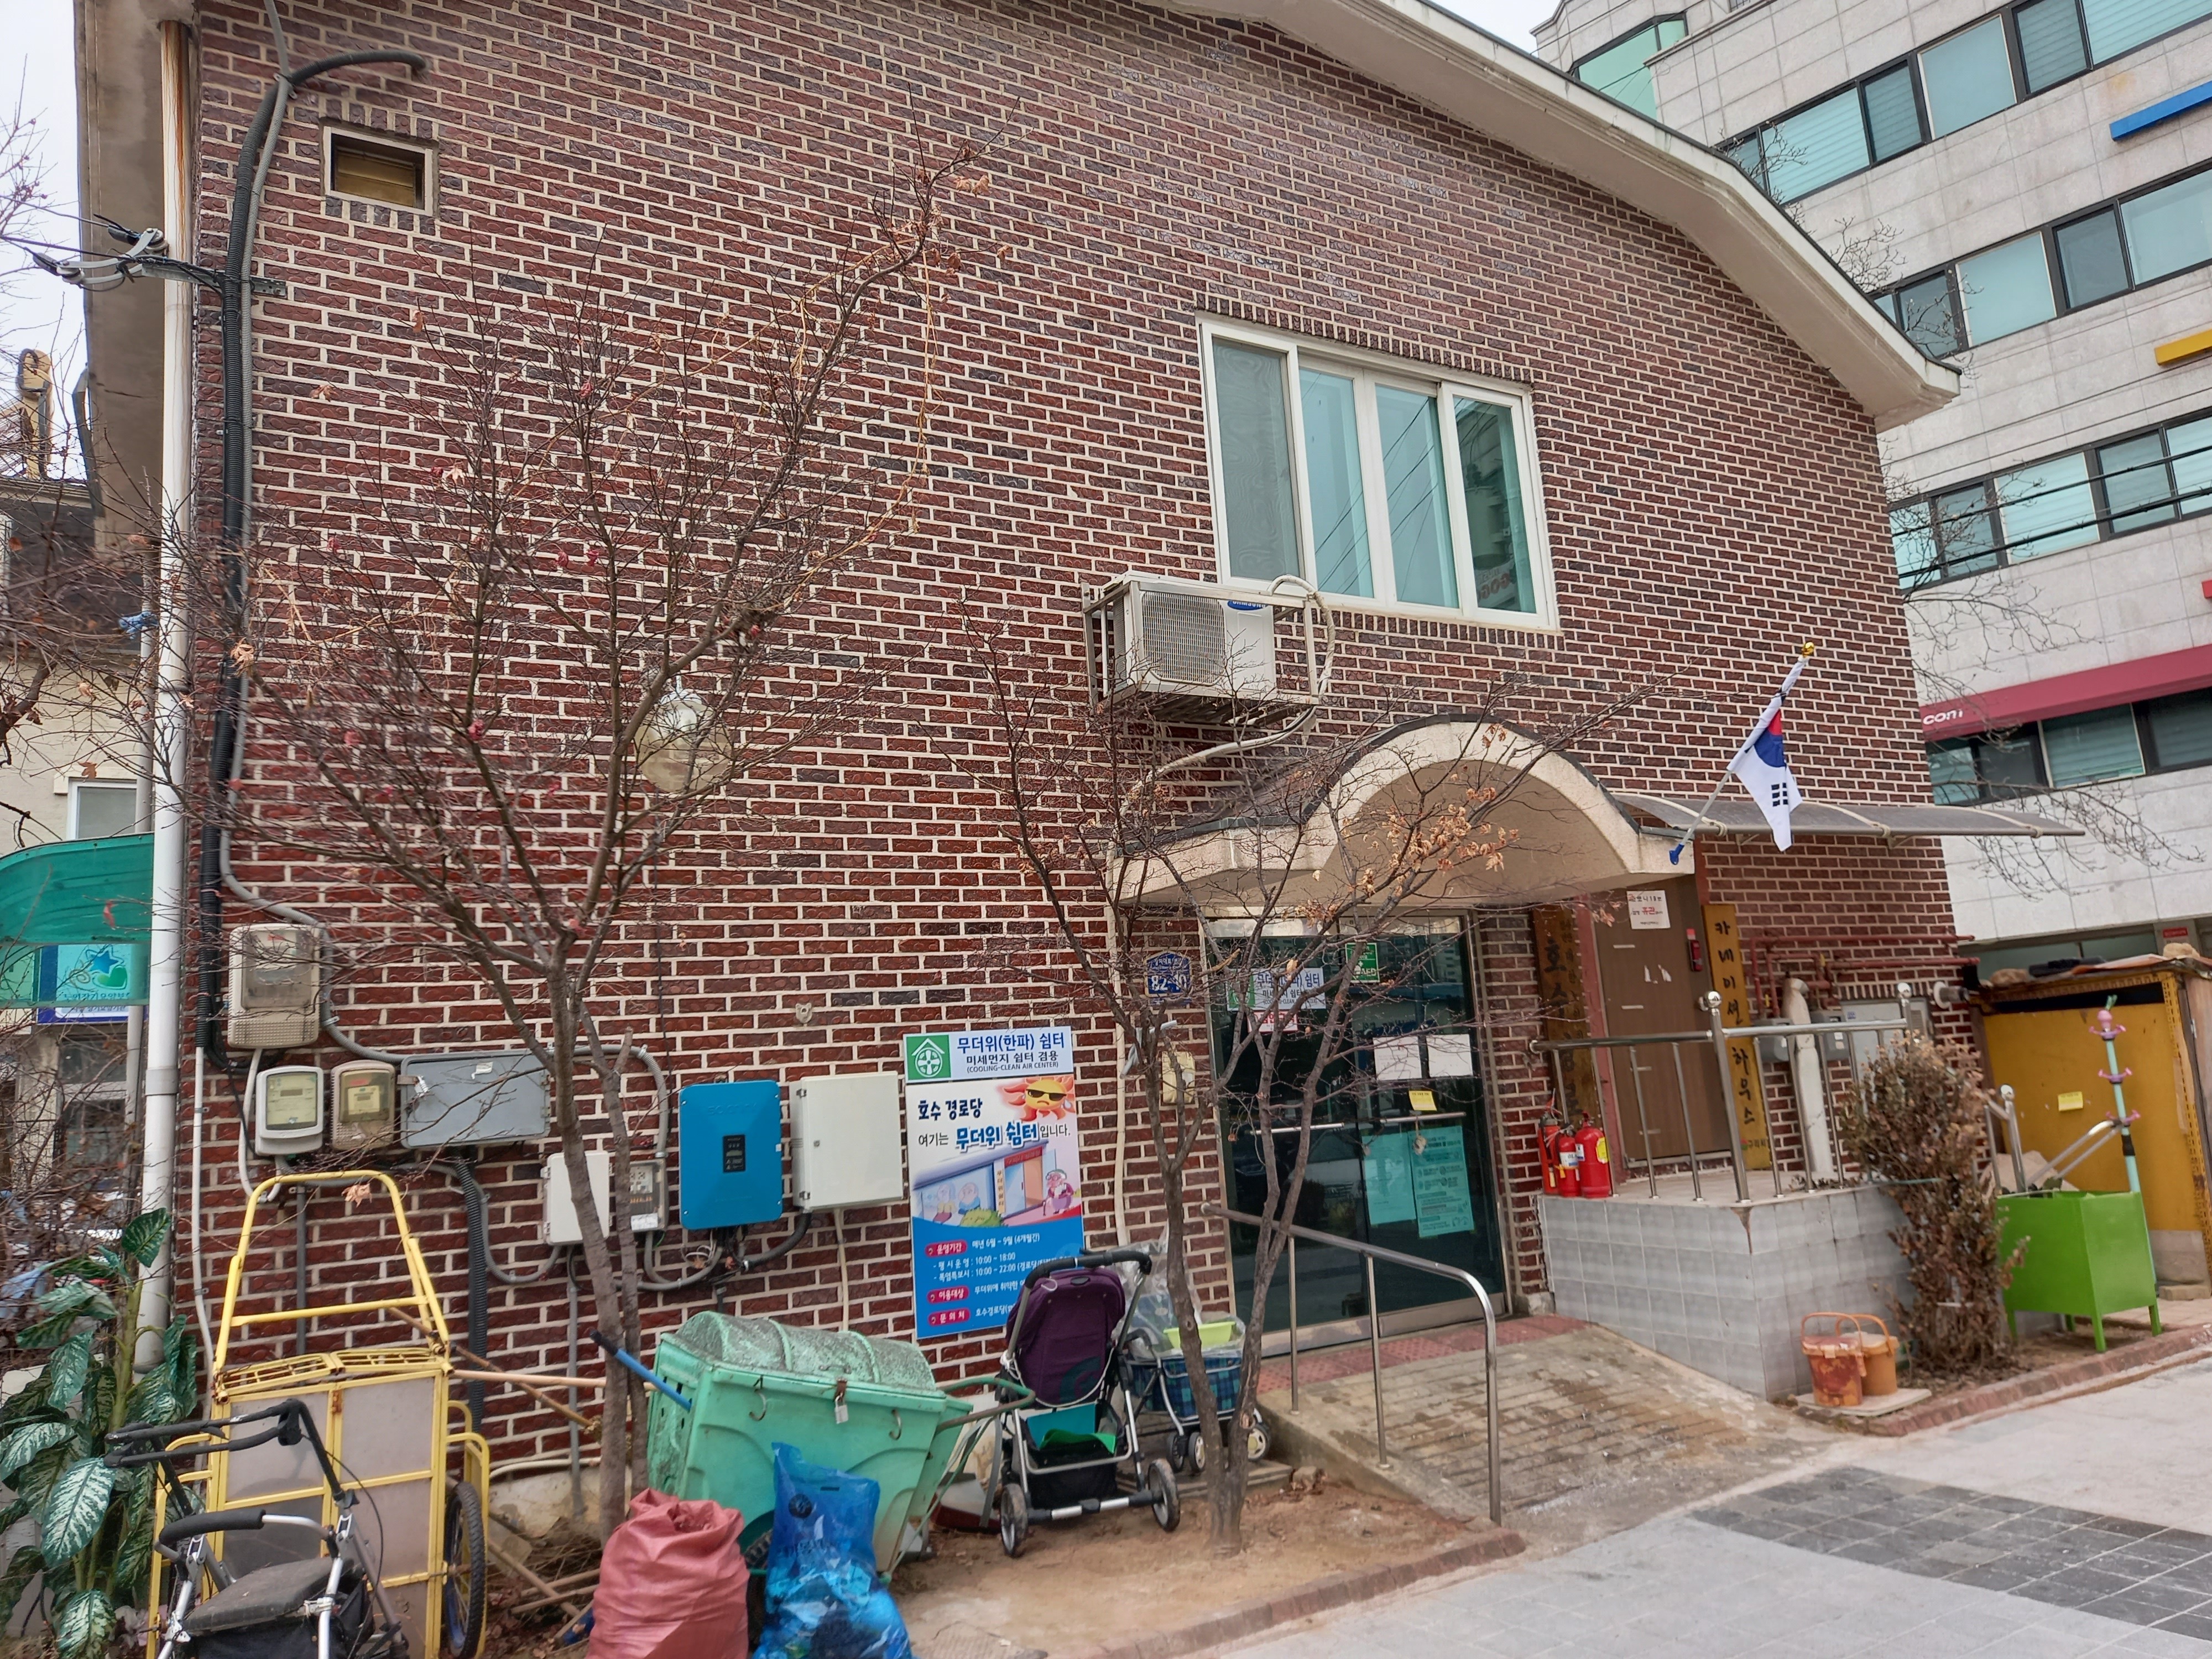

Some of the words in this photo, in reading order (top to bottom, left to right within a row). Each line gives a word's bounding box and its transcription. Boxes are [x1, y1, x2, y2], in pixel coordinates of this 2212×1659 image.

[1305, 972, 1320, 987] 쉼터
[957, 1034, 1035, 1054] 무더위(한파)
[1040, 1032, 1065, 1050] 쉼터
[967, 1053, 1009, 1065] 미세먼지
[1038, 1050, 1058, 1061] 겸용
[967, 1065, 1020, 1073] (COOLING-CLEAN
[918, 1099, 941, 1120] 호수
[945, 1098, 983, 1120] 경로당
[918, 1132, 949, 1147] 여기는
[956, 1125, 1001, 1152] 무더위
[937, 1241, 962, 1255] 운영기간
[972, 1239, 984, 1250] 매년
[985, 1237, 996, 1248] 6월
[1003, 1235, 1013, 1246] 9월
[1014, 1232, 1040, 1244] (4개월간)
[975, 1254, 992, 1265] 10:00
[999, 1251, 1016, 1262] 18:00
[938, 1269, 970, 1283] 폭염특보시
[975, 1266, 992, 1277] 10:00
[999, 1262, 1016, 1272] 22:00
[938, 1287, 964, 1301] 이용대상
[974, 1283, 999, 1295] 무더위에
[1000, 1279, 1018, 1291] 취약한
